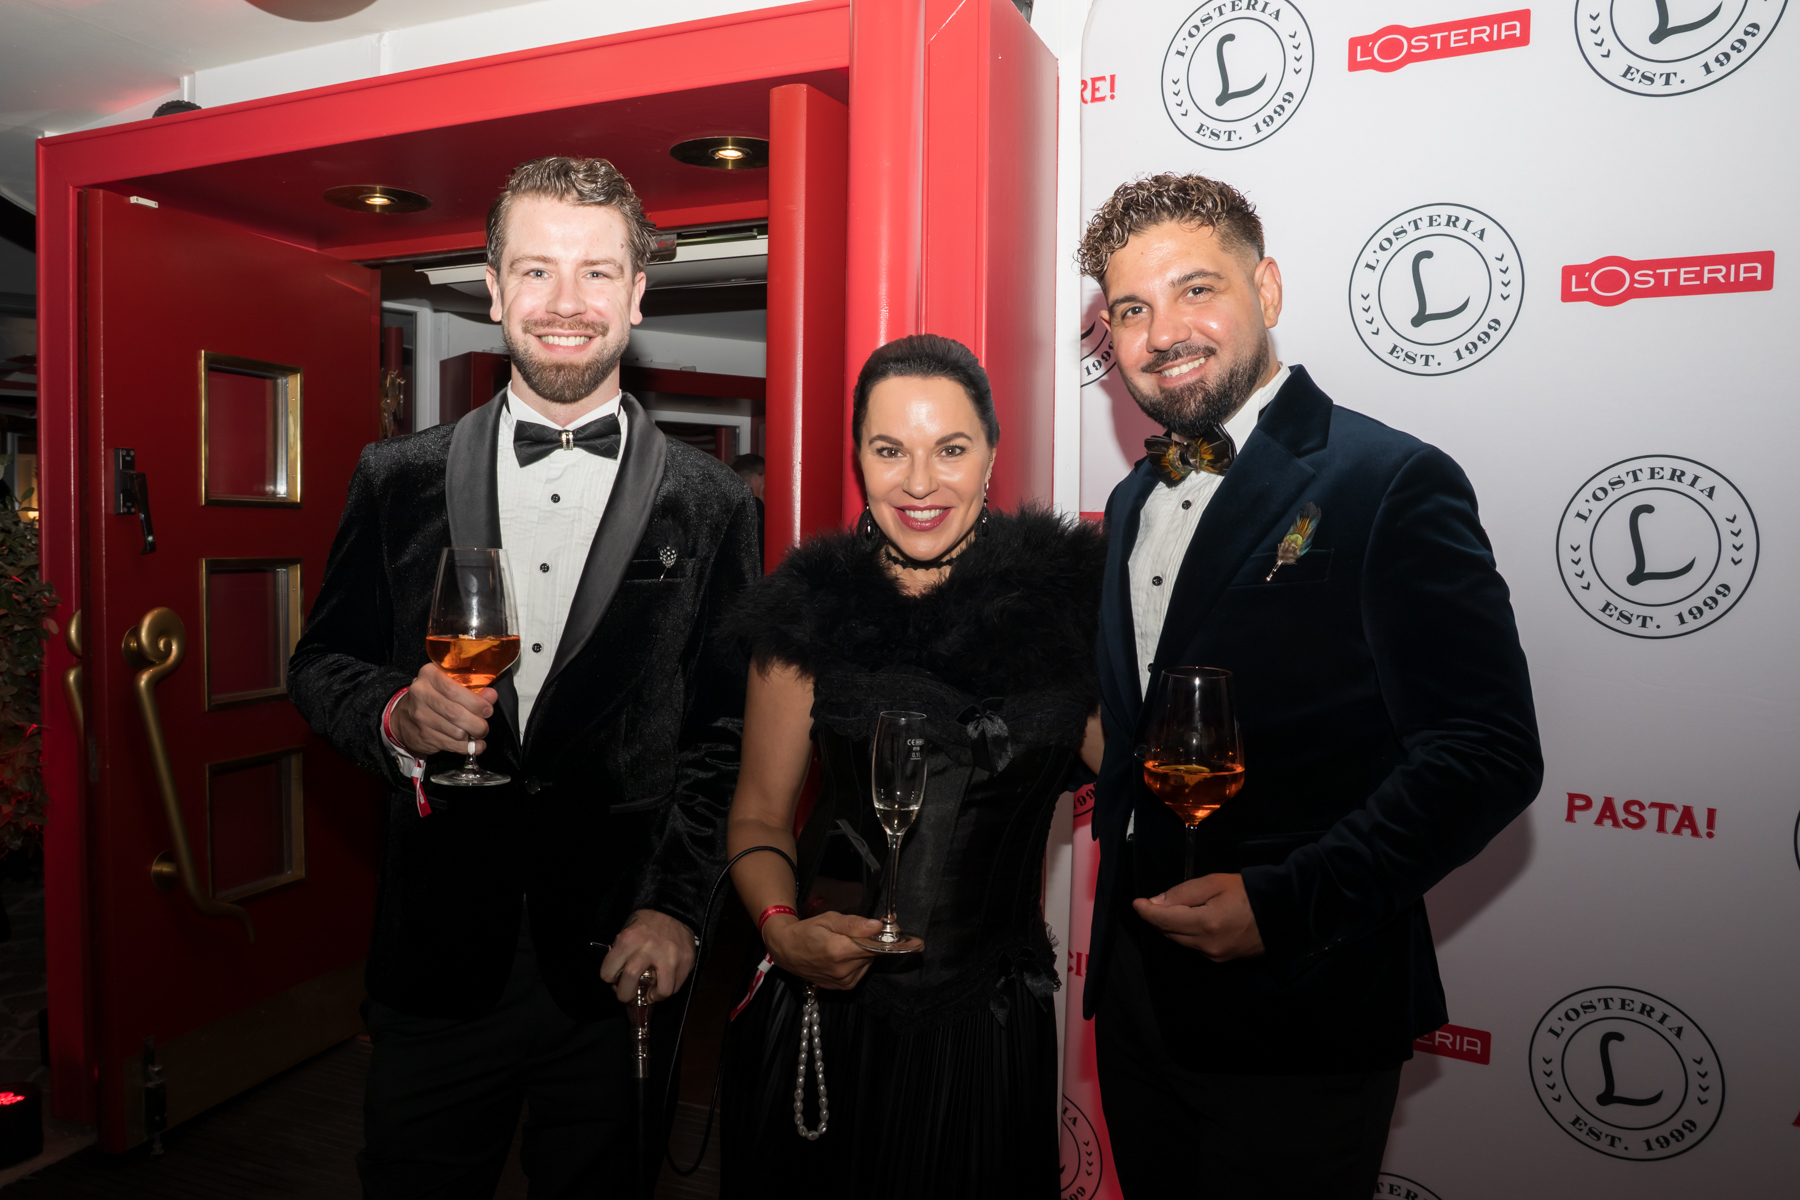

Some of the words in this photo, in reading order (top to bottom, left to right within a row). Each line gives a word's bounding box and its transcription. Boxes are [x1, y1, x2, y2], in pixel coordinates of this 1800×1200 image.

[1175, 0, 1281, 58] L'OSTERIA
[1356, 20, 1521, 63] L'OSTERIA
[1620, 64, 1686, 87] EST.
[1700, 22, 1761, 77] 1999
[1215, 33, 1267, 106] L
[1194, 121, 1243, 142] EST.
[1252, 91, 1295, 134] 1999
[1364, 213, 1486, 273] L'OSTERIA
[1410, 249, 1471, 328] L
[1571, 262, 1762, 297] L'OSTERIA
[1387, 342, 1442, 368] EST.
[1453, 318, 1502, 362] 1999
[1574, 465, 1717, 524] L'OSTERIA
[1625, 503, 1697, 587] L
[1598, 599, 1661, 630] EST.
[1674, 583, 1732, 626] 1999
[1564, 792, 1717, 840] PASTA!
[1547, 997, 1685, 1040] L'OSTERIA
[1595, 1031, 1664, 1107] L
[1568, 1114, 1630, 1151] EST.
[1642, 1118, 1698, 1152] 1999
